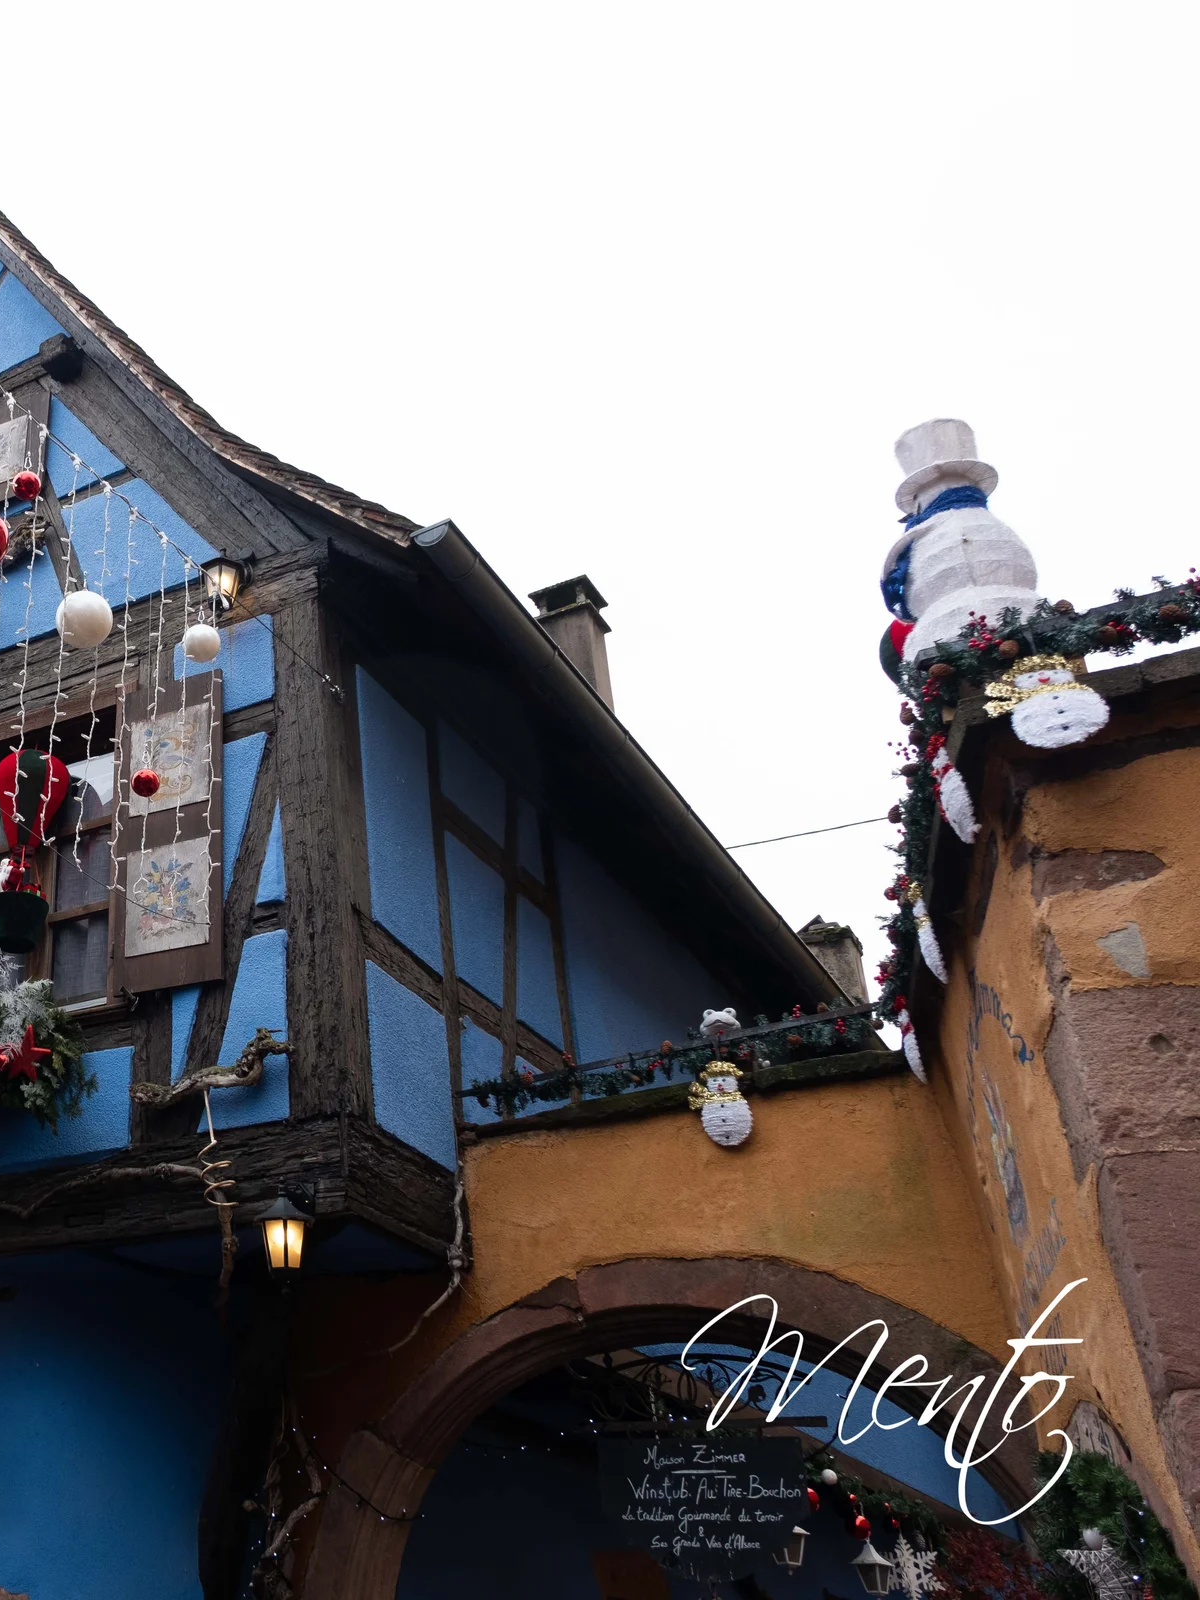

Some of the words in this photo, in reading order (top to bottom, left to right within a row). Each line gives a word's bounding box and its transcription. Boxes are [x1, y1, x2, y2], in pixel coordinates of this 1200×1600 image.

[643, 1445, 685, 1470] Maison
[696, 1477, 716, 1505] Au
[637, 1506, 675, 1522] tradition
[738, 1508, 752, 1522] du
[755, 1509, 784, 1522] terroir
[724, 1533, 761, 1550] d'Alsace
